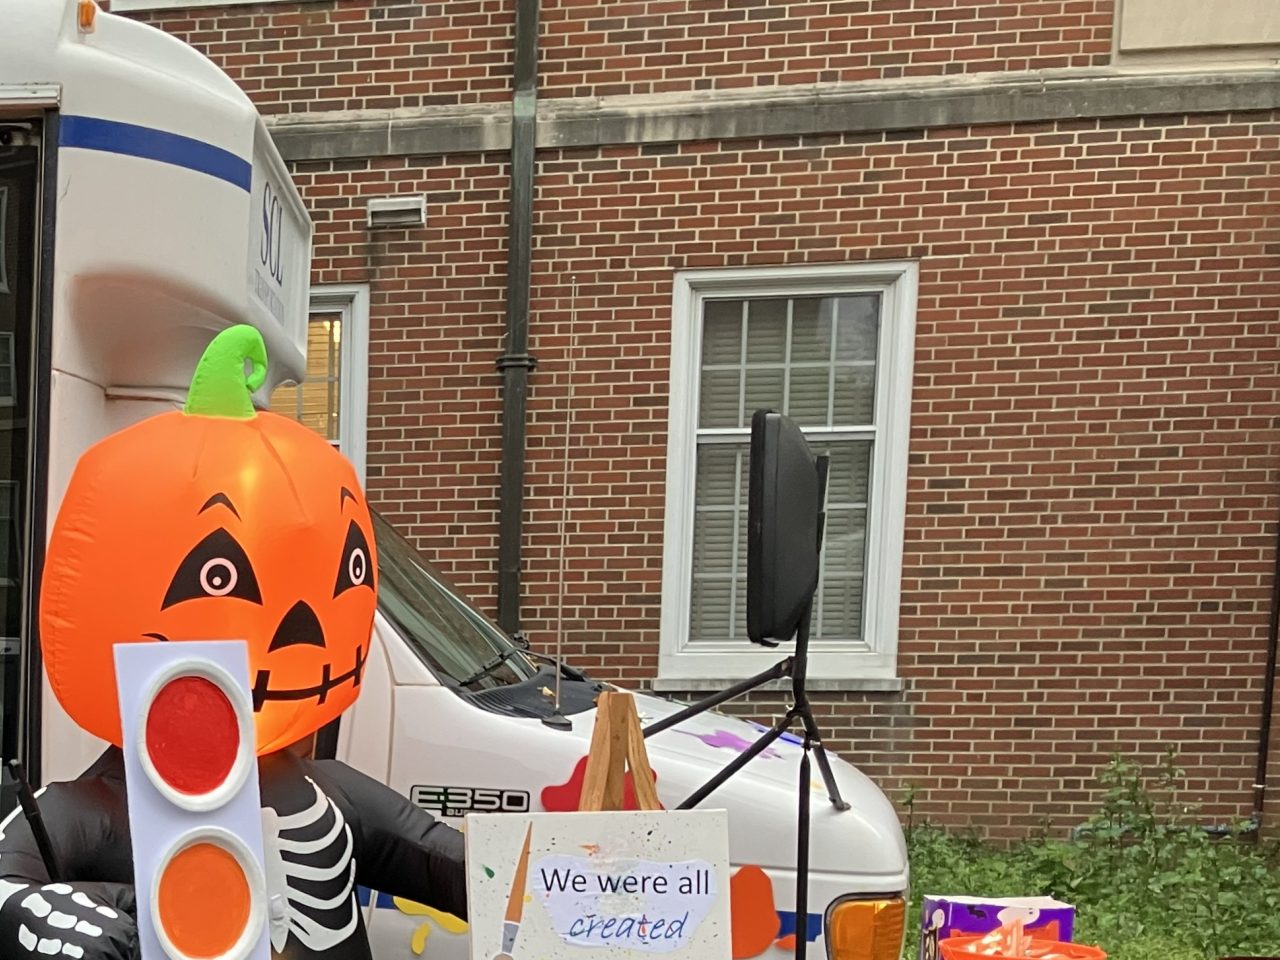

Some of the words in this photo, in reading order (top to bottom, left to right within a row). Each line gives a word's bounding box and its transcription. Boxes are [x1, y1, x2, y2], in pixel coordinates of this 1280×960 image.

[261, 181, 284, 287] SCL
[541, 868, 587, 893] We
[597, 874, 668, 895] were
[678, 870, 709, 895] all
[569, 911, 689, 940] created
